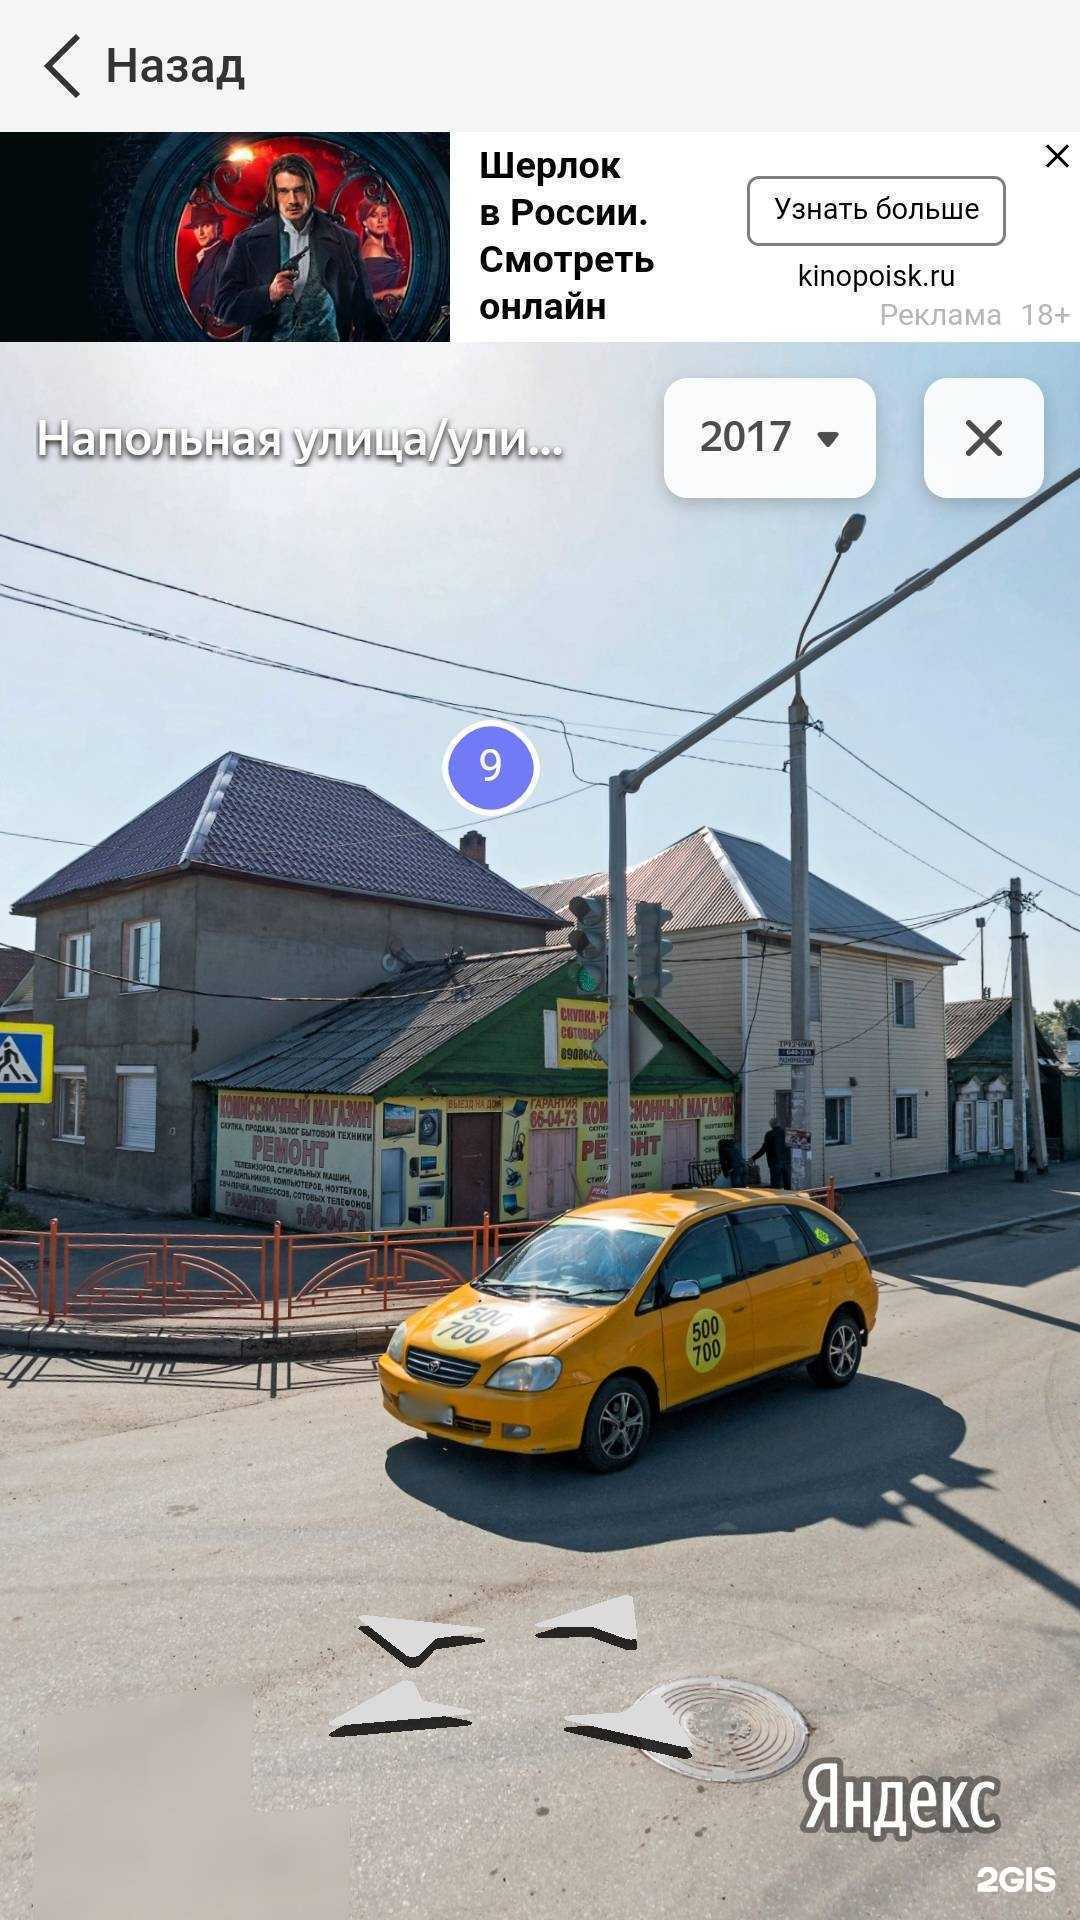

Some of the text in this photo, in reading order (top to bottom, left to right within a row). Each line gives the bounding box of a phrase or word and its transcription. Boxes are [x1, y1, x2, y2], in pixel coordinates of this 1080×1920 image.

[530, 1098, 577, 1109] ГАРАНТИЯ
[530, 1109, 577, 1128] 66-04-73
[301, 1127, 336, 1139] БЫТОВОЙ
[337, 1130, 373, 1142] ТЕХНИКИ
[252, 1135, 329, 1168] РЕМОНТ
[277, 1166, 321, 1179] СТИРАЛЬНЫХ
[292, 1191, 326, 1203] СОТОВЫХ
[327, 1196, 372, 1210] ТЕЛЕФОНОВ
[325, 1184, 370, 1198] НОУТБУКОВ,
[437, 1321, 490, 1344] 700
[692, 1315, 719, 1342] 500
[692, 1338, 721, 1366] 700
